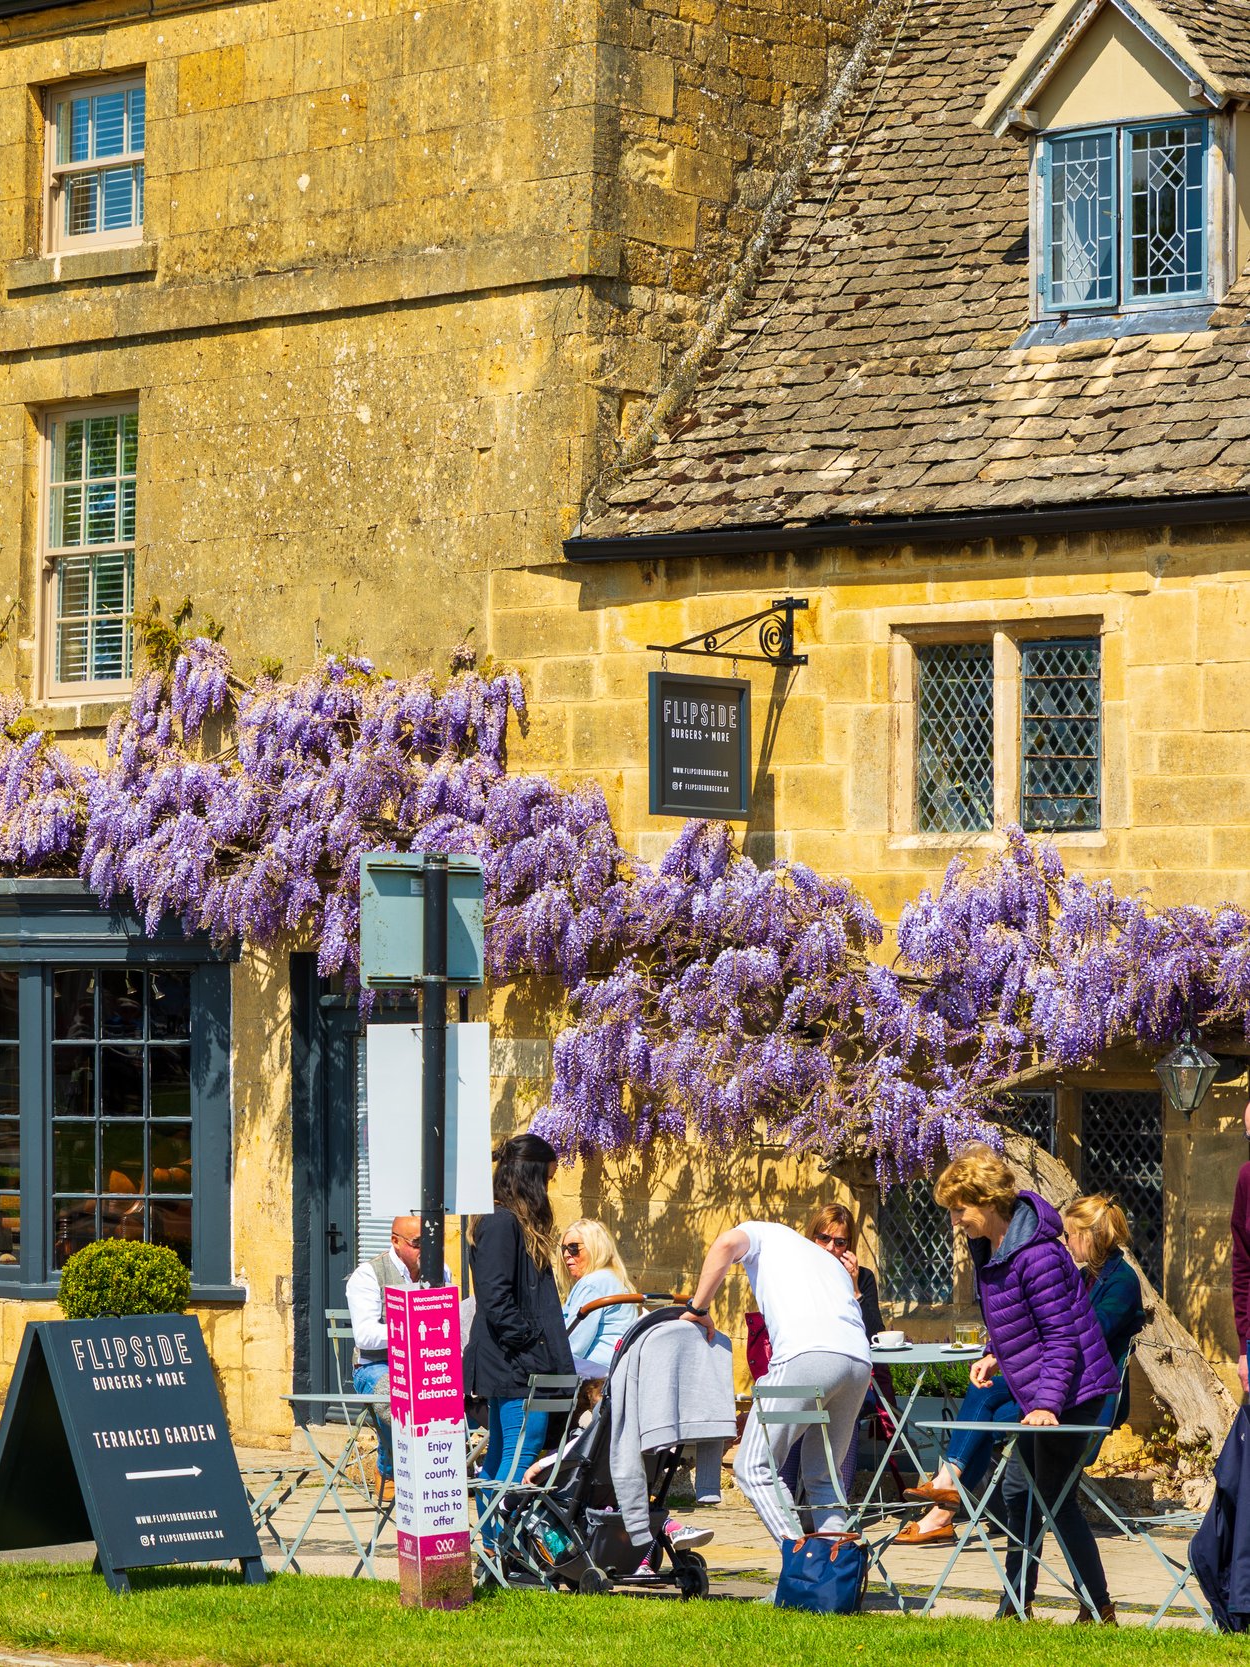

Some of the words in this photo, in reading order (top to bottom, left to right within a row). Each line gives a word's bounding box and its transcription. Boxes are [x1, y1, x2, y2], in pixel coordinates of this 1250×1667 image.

[671, 728, 703, 741] BURGERS
[711, 731, 730, 743] MORE
[413, 1303, 442, 1312] Welcomes
[442, 1302, 453, 1310] You
[419, 1347, 452, 1359] Please
[424, 1361, 449, 1373] keep
[92, 1374, 143, 1391] BURGERS
[156, 1371, 187, 1387] MORE
[422, 1377, 429, 1386] a
[431, 1373, 452, 1385] safe
[417, 1388, 458, 1401] distance
[92, 1428, 161, 1449] TERRACED
[164, 1424, 217, 1444] GARDEN
[427, 1441, 453, 1453] Enjoy
[433, 1455, 449, 1465] our
[424, 1467, 458, 1480] county.
[423, 1490, 430, 1500] It
[431, 1488, 448, 1499] has
[451, 1487, 462, 1497] so
[424, 1502, 450, 1514] much
[453, 1501, 462, 1511] to
[135, 1509, 218, 1525] WWW.FLIPSIDEBURGERS.UK
[432, 1515, 455, 1527] offer
[158, 1530, 225, 1544] FLIPSIDEBURGERS.UK
